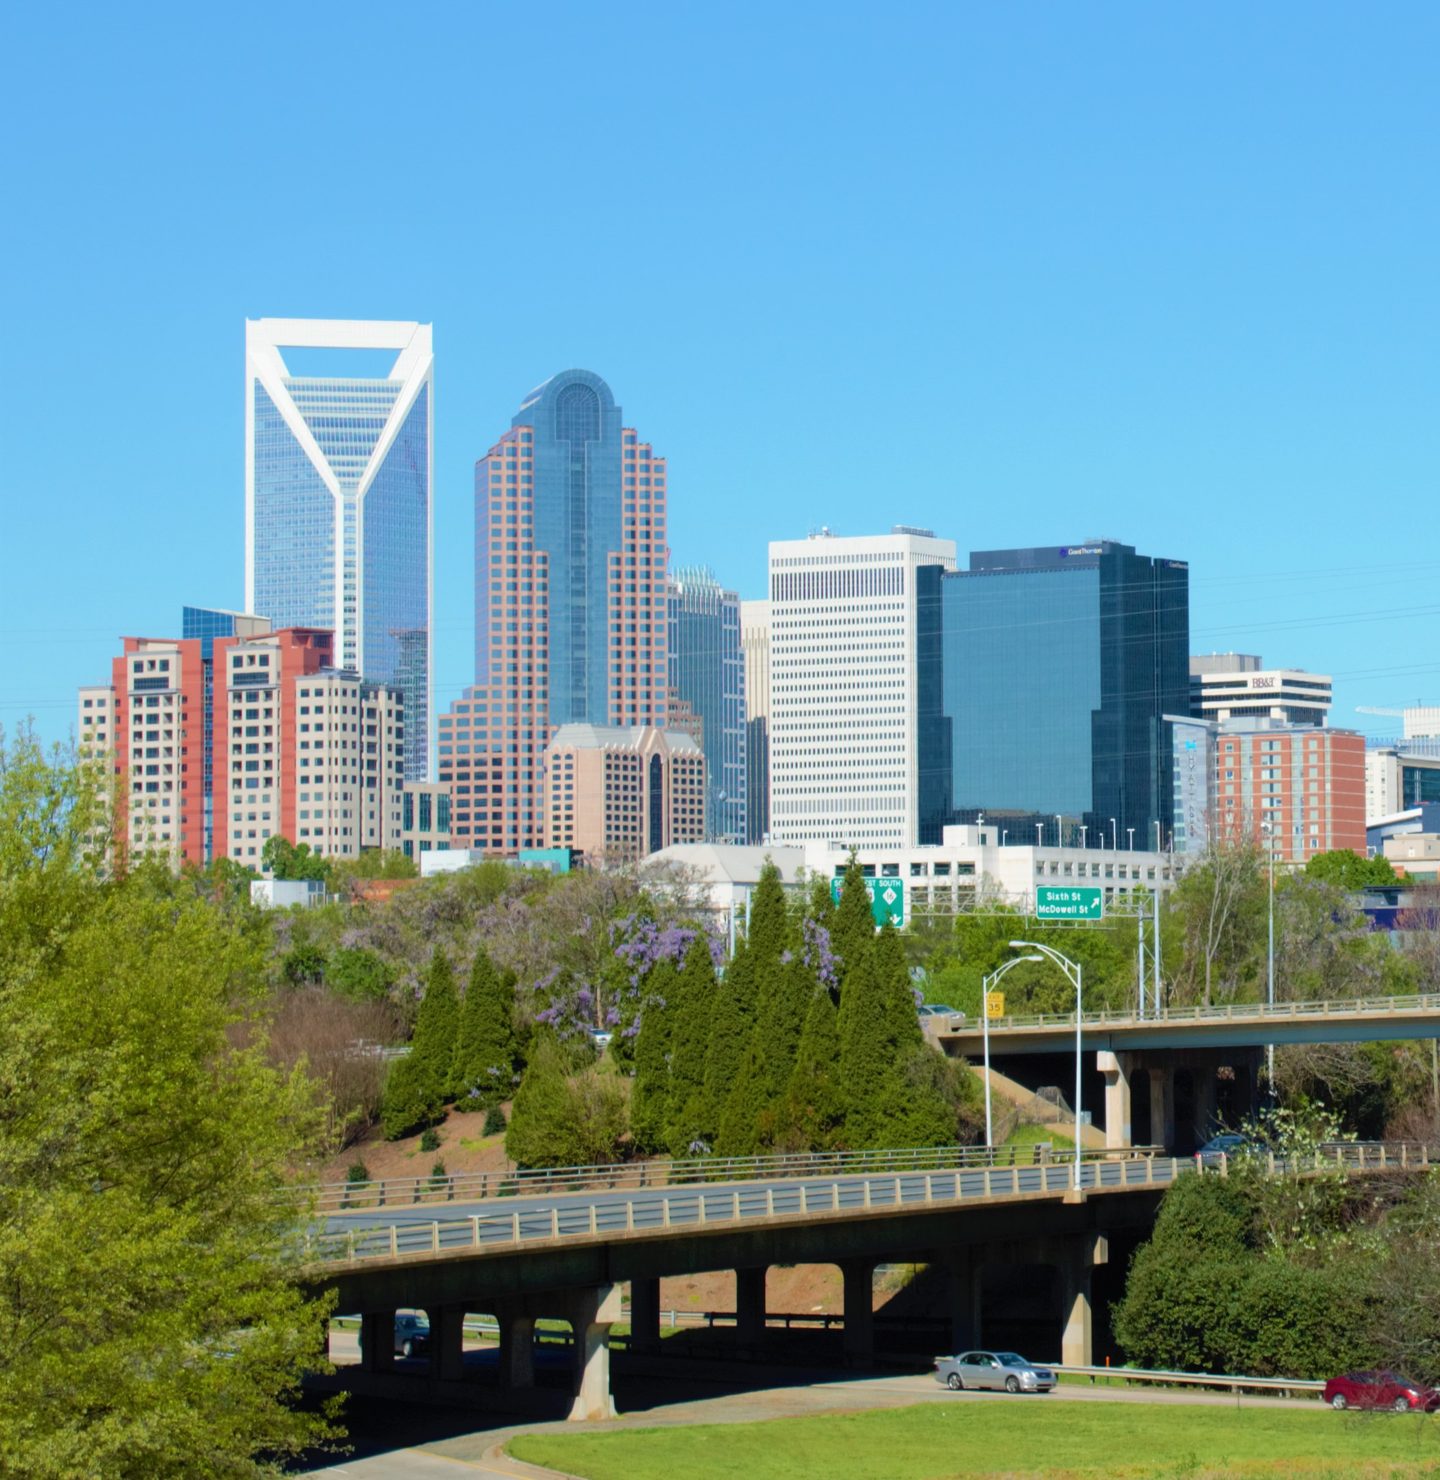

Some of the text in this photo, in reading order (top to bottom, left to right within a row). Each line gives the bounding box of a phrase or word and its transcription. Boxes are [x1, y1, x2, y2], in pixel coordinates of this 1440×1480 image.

[1252, 677, 1275, 688] BB&T
[878, 880, 901, 888] SOUTH
[1046, 891, 1081, 901] Sixth St
[1038, 904, 1088, 914] McDowell St
[988, 1003, 1001, 1011] 35
